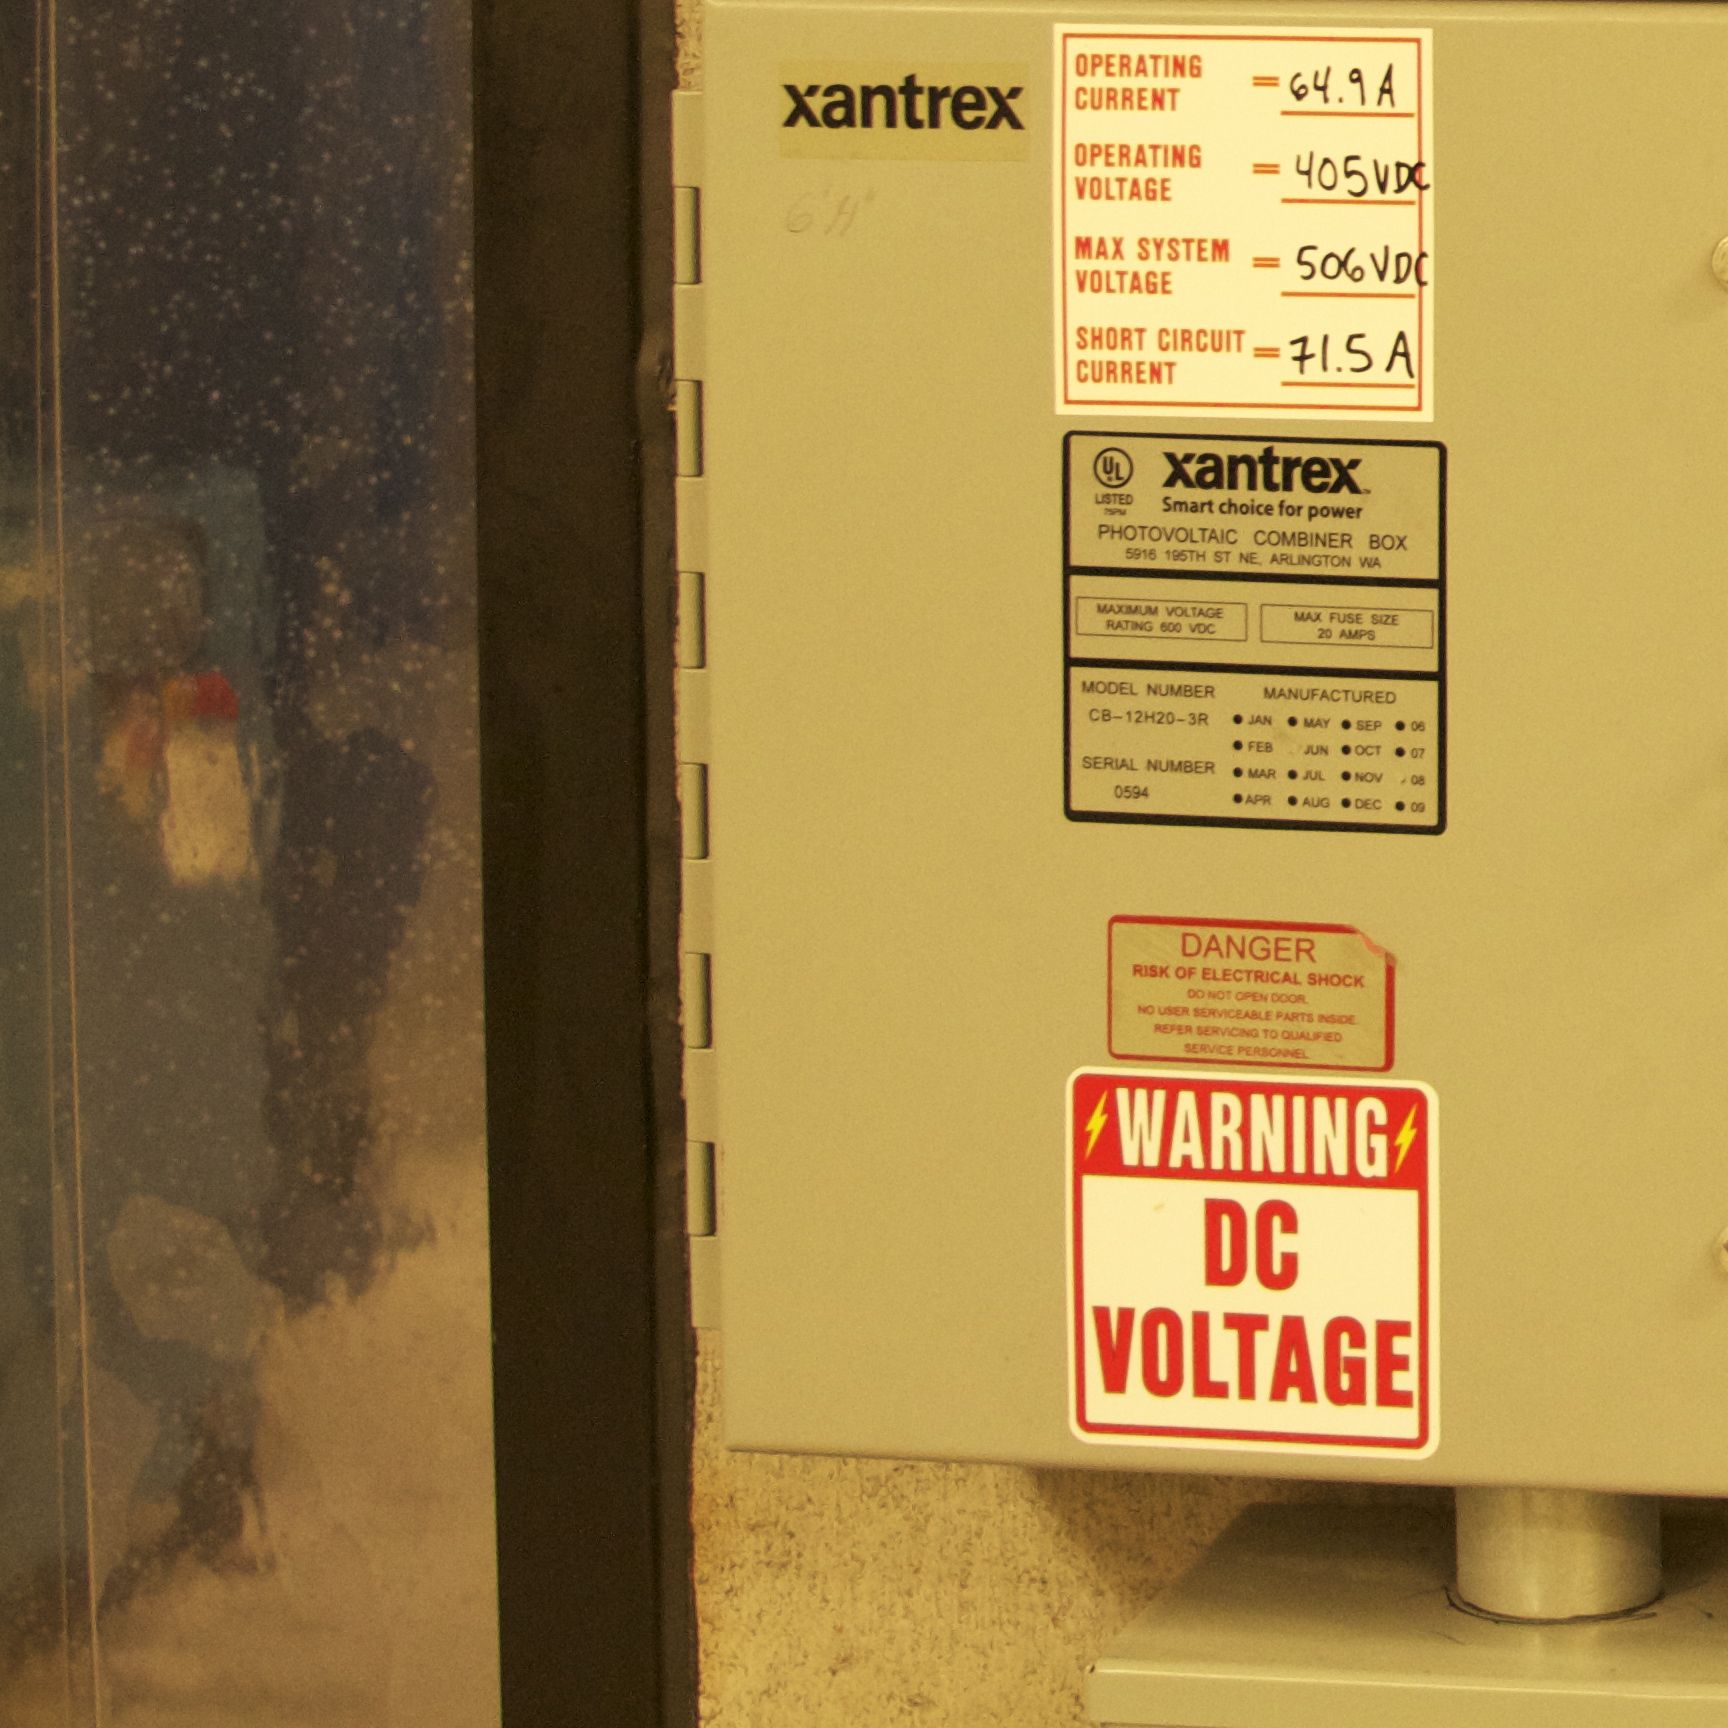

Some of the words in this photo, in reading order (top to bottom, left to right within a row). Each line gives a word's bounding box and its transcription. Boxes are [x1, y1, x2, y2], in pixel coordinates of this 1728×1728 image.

[1075, 53, 1202, 78] OPERATING
[1289, 66, 1366, 106] 64.9
[1377, 63, 1395, 108] A
[782, 73, 1025, 130] xantrex
[1075, 86, 1180, 111] CURRENT
[1074, 143, 1201, 168] OPERATING
[1075, 176, 1171, 202] VOLTAGE
[1075, 236, 1124, 260] MAX
[1137, 237, 1230, 262] SYSTEM
[1075, 269, 1172, 295] VOLTAGE
[1076, 326, 1147, 351] SHORT
[1158, 328, 1246, 353] CIRCUIT
[1289, 333, 1373, 375] 71.5
[1385, 330, 1415, 379] A
[1076, 359, 1176, 384] CURRENT
[1095, 493, 1133, 505] LISTED
[1162, 496, 1214, 514] Smart
[1218, 498, 1274, 516] choice
[1278, 500, 1304, 517] for
[1308, 505, 1363, 522] power
[1098, 524, 1238, 545] PHOTOVOLTAIC
[1253, 530, 1353, 549] COMBINER
[1369, 534, 1407, 551] BOX
[1125, 547, 1157, 561] 5916
[1165, 549, 1206, 562] 195TH
[1214, 550, 1232, 563] ST
[1269, 553, 1351, 568] ARLINGTON
[1359, 557, 1381, 568] WA
[1096, 603, 1158, 616] MAXIMUM
[1165, 606, 1224, 619] VOLTAGE
[1294, 611, 1322, 623] MAX
[1329, 612, 1363, 625] FUSE
[1371, 614, 1399, 626] SIZE
[1106, 619, 1154, 632] RATING
[1160, 622, 1182, 633] 600
[1189, 623, 1216, 635] VDC
[1317, 628, 1333, 639] 20
[1339, 629, 1376, 641] AMPS
[1081, 680, 1138, 696] MODEL
[1147, 683, 1215, 698] NUMBER
[1263, 686, 1397, 704] MANUFACTURED
[1248, 715, 1272, 726] JAN
[1303, 717, 1331, 728] MAY
[1356, 720, 1382, 731] SEP
[1411, 720, 1426, 732] 06
[1248, 741, 1273, 753] FEB
[1303, 745, 1329, 756] JUN
[1354, 744, 1382, 757] OCT
[1410, 747, 1426, 759] 07
[1082, 756, 1137, 771] SERIAL
[1146, 759, 1215, 774] NUMBER
[1248, 768, 1276, 779] MAR
[1302, 769, 1325, 781] JUL
[1354, 772, 1383, 783] NOV
[1410, 774, 1425, 786] 08
[1114, 785, 1150, 799] 0594
[1245, 794, 1271, 805] APR
[1302, 797, 1330, 808] AUG
[1354, 798, 1382, 810] DEC
[1410, 801, 1426, 813] 09
[1181, 932, 1316, 963] DANGER
[1132, 964, 1170, 978] RISK
[1174, 966, 1196, 980] OF
[1201, 967, 1302, 986] ELECTRICAL
[1307, 972, 1365, 988] SHOCK
[1187, 988, 1205, 999] DO
[1206, 990, 1232, 1001] NOT
[1235, 991, 1269, 1003] OPEN
[1137, 1005, 1155, 1015] NO
[1158, 1005, 1190, 1017] USER
[1192, 1007, 1272, 1021] SERVICEABLE
[1275, 1011, 1314, 1023] PARTS
[1154, 1023, 1193, 1035] REFER
[1196, 1025, 1259, 1039] SERVICING
[1262, 1028, 1279, 1040] TO
[1281, 1030, 1343, 1043] QUALIFIED
[1184, 1043, 1234, 1056] SERVICE
[1116, 1087, 1388, 1178] WARNING
[1204, 1198, 1298, 1291] DC
[1092, 1306, 1413, 1408] VOLTAGE
